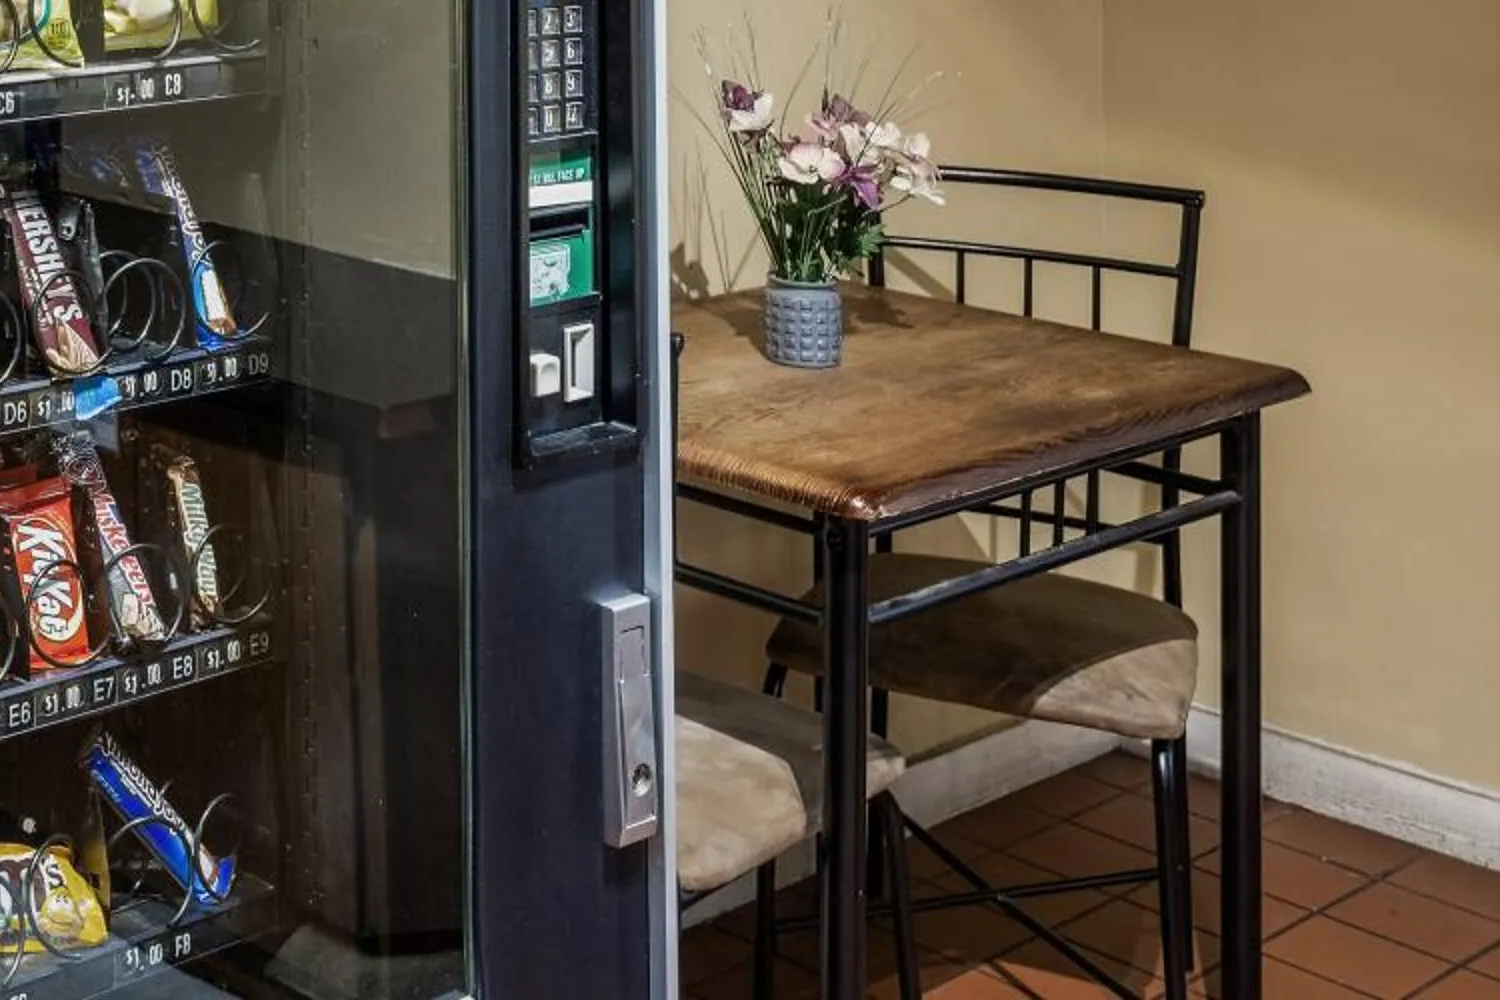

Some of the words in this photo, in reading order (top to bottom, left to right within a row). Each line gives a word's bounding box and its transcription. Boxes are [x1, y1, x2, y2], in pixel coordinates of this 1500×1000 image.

[165, 73, 181, 96] C8
[172, 369, 191, 392] D8
[4, 402, 27, 425] D6
[173, 655, 193, 679] E8
[94, 677, 114, 701] E7
[9, 702, 30, 727] E6
[175, 933, 192, 957] F8
